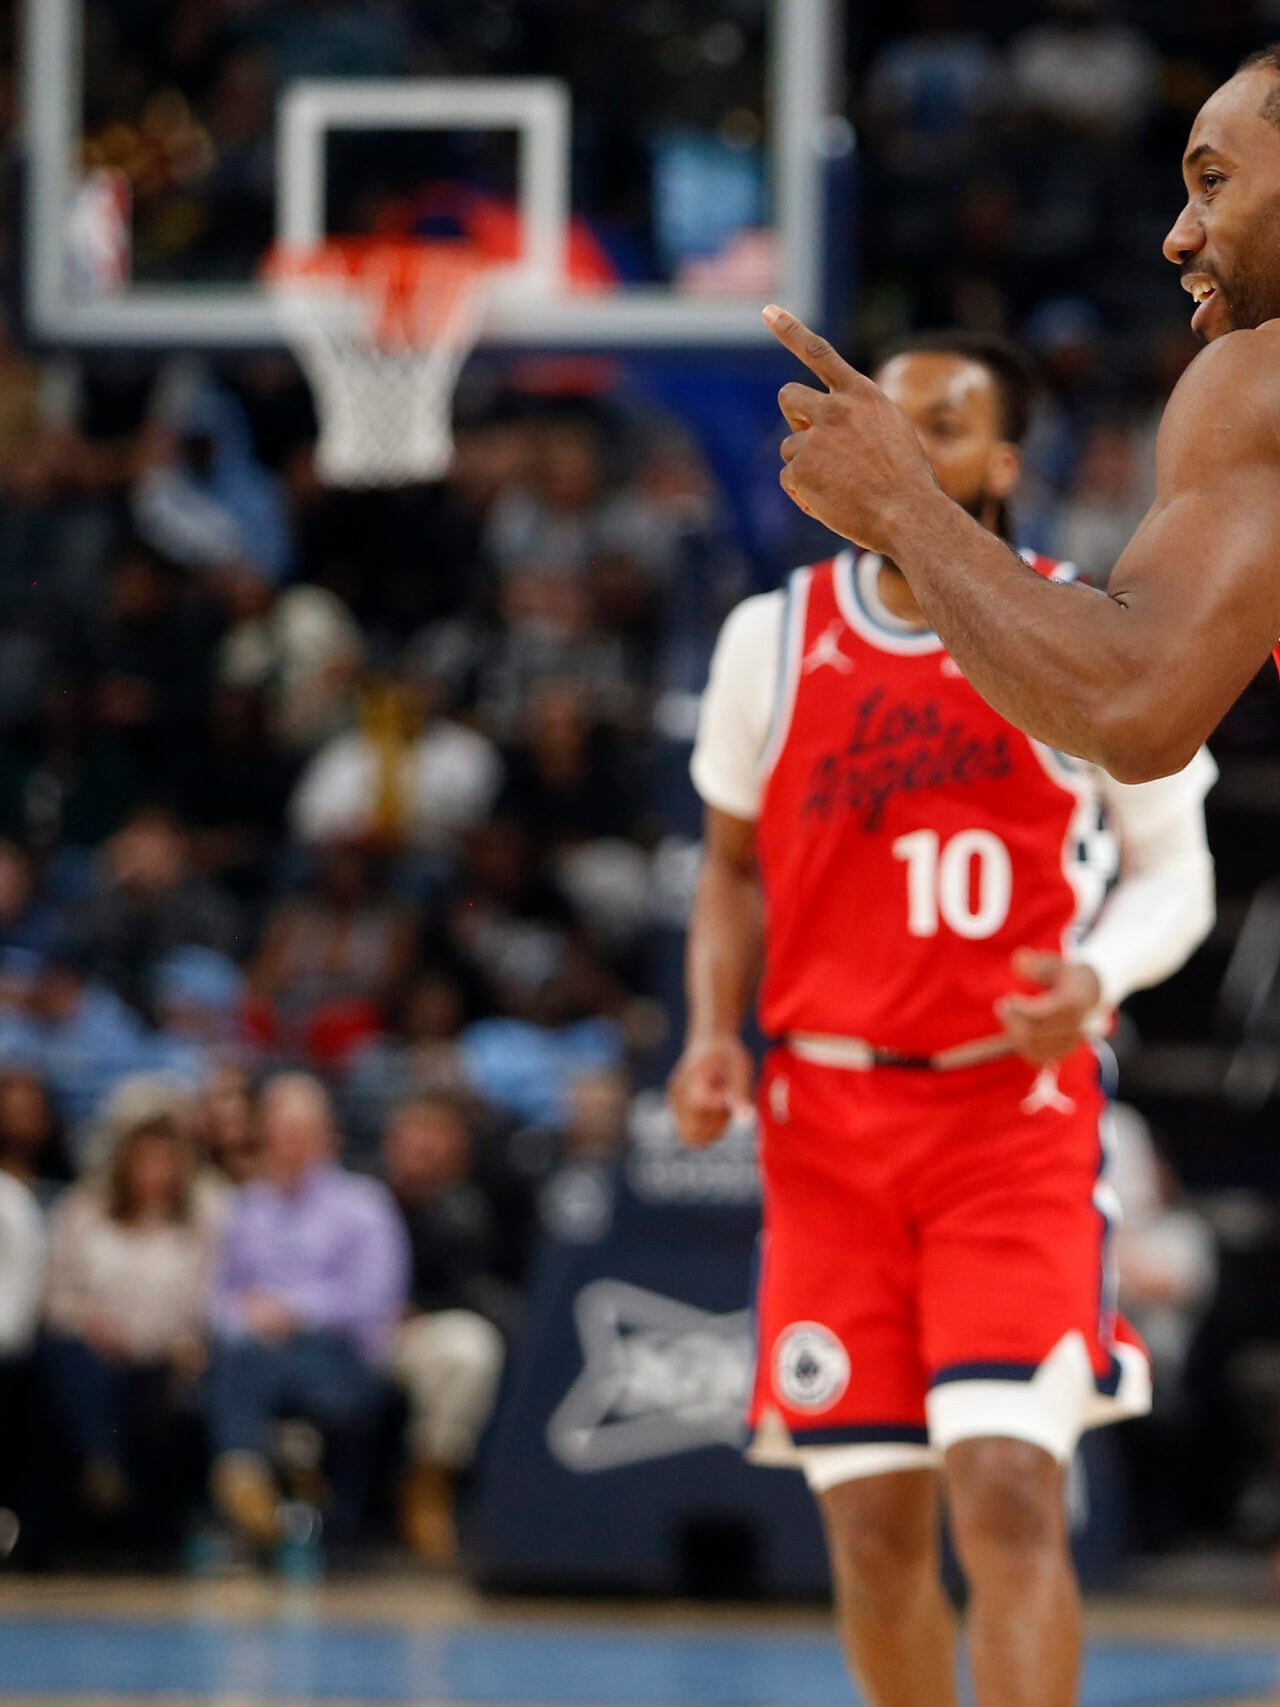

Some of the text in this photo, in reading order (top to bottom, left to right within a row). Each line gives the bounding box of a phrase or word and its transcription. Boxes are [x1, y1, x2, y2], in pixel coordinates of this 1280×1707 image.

[848, 684, 941, 757] Los
[800, 721, 1013, 834] Angeles
[892, 827, 1013, 941] 10
